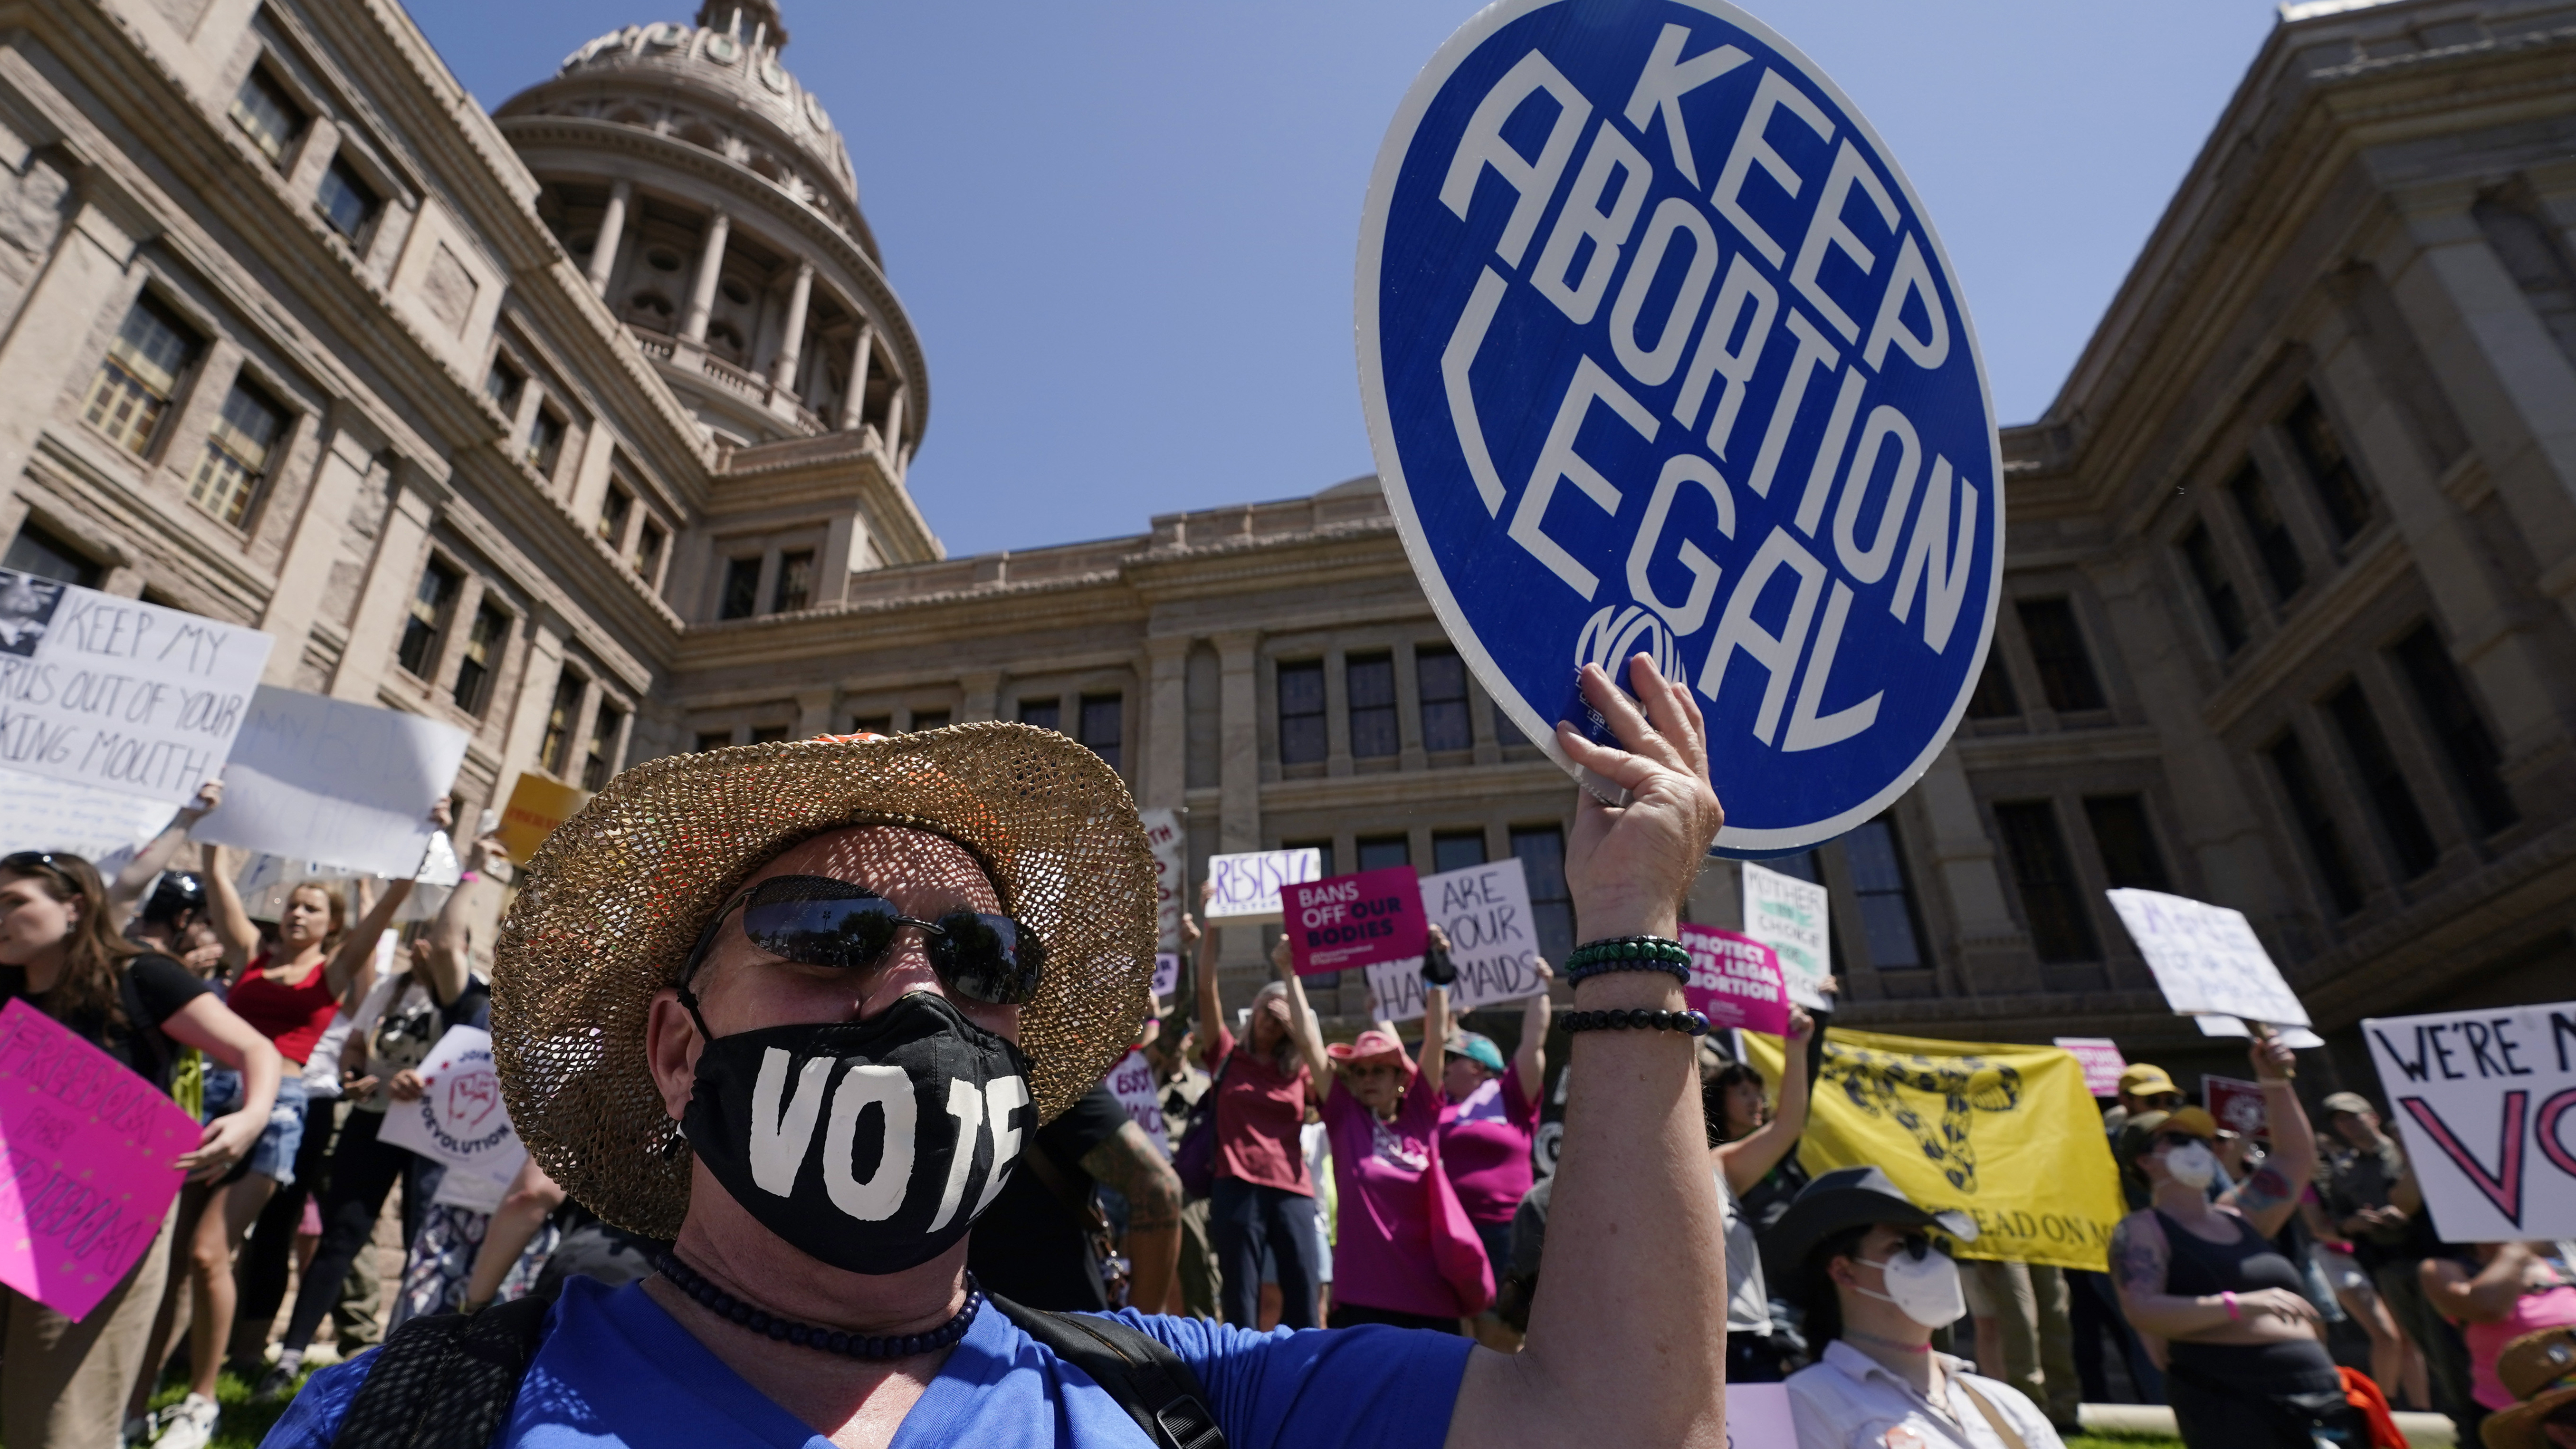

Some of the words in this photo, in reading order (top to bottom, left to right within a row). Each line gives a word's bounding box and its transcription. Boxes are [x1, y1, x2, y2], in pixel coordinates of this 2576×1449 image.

[1623, 22, 1950, 373] KEEP
[1438, 48, 1978, 655] ABORTION
[1441, 264, 1885, 752] LEGAL
[57, 595, 155, 658] KEEP
[157, 622, 229, 677] MY
[0, 655, 60, 705] RUS
[60, 670, 135, 718] OUT
[125, 680, 171, 726] OF
[174, 686, 243, 738] YOUR
[1587, 710, 1605, 726] FOR
[78, 729, 211, 792] MOUTH
[1298, 881, 1360, 908] BANS
[1302, 903, 1347, 928] OFF
[1350, 896, 1402, 919] OUR
[1442, 871, 1506, 915] ARE
[1307, 919, 1394, 948] BODIES
[1435, 904, 1523, 954] YOUR
[1681, 932, 1765, 964] PROTECT
[1378, 949, 1540, 1020] HAMAIDS
[1687, 970, 1779, 1003] BORTION
[1724, 958, 1782, 988] LEGAL
[2372, 1018, 2534, 1083] WE'RE
[749, 1046, 1030, 1234] VOTE
[2042, 1213, 2086, 1245] ON
